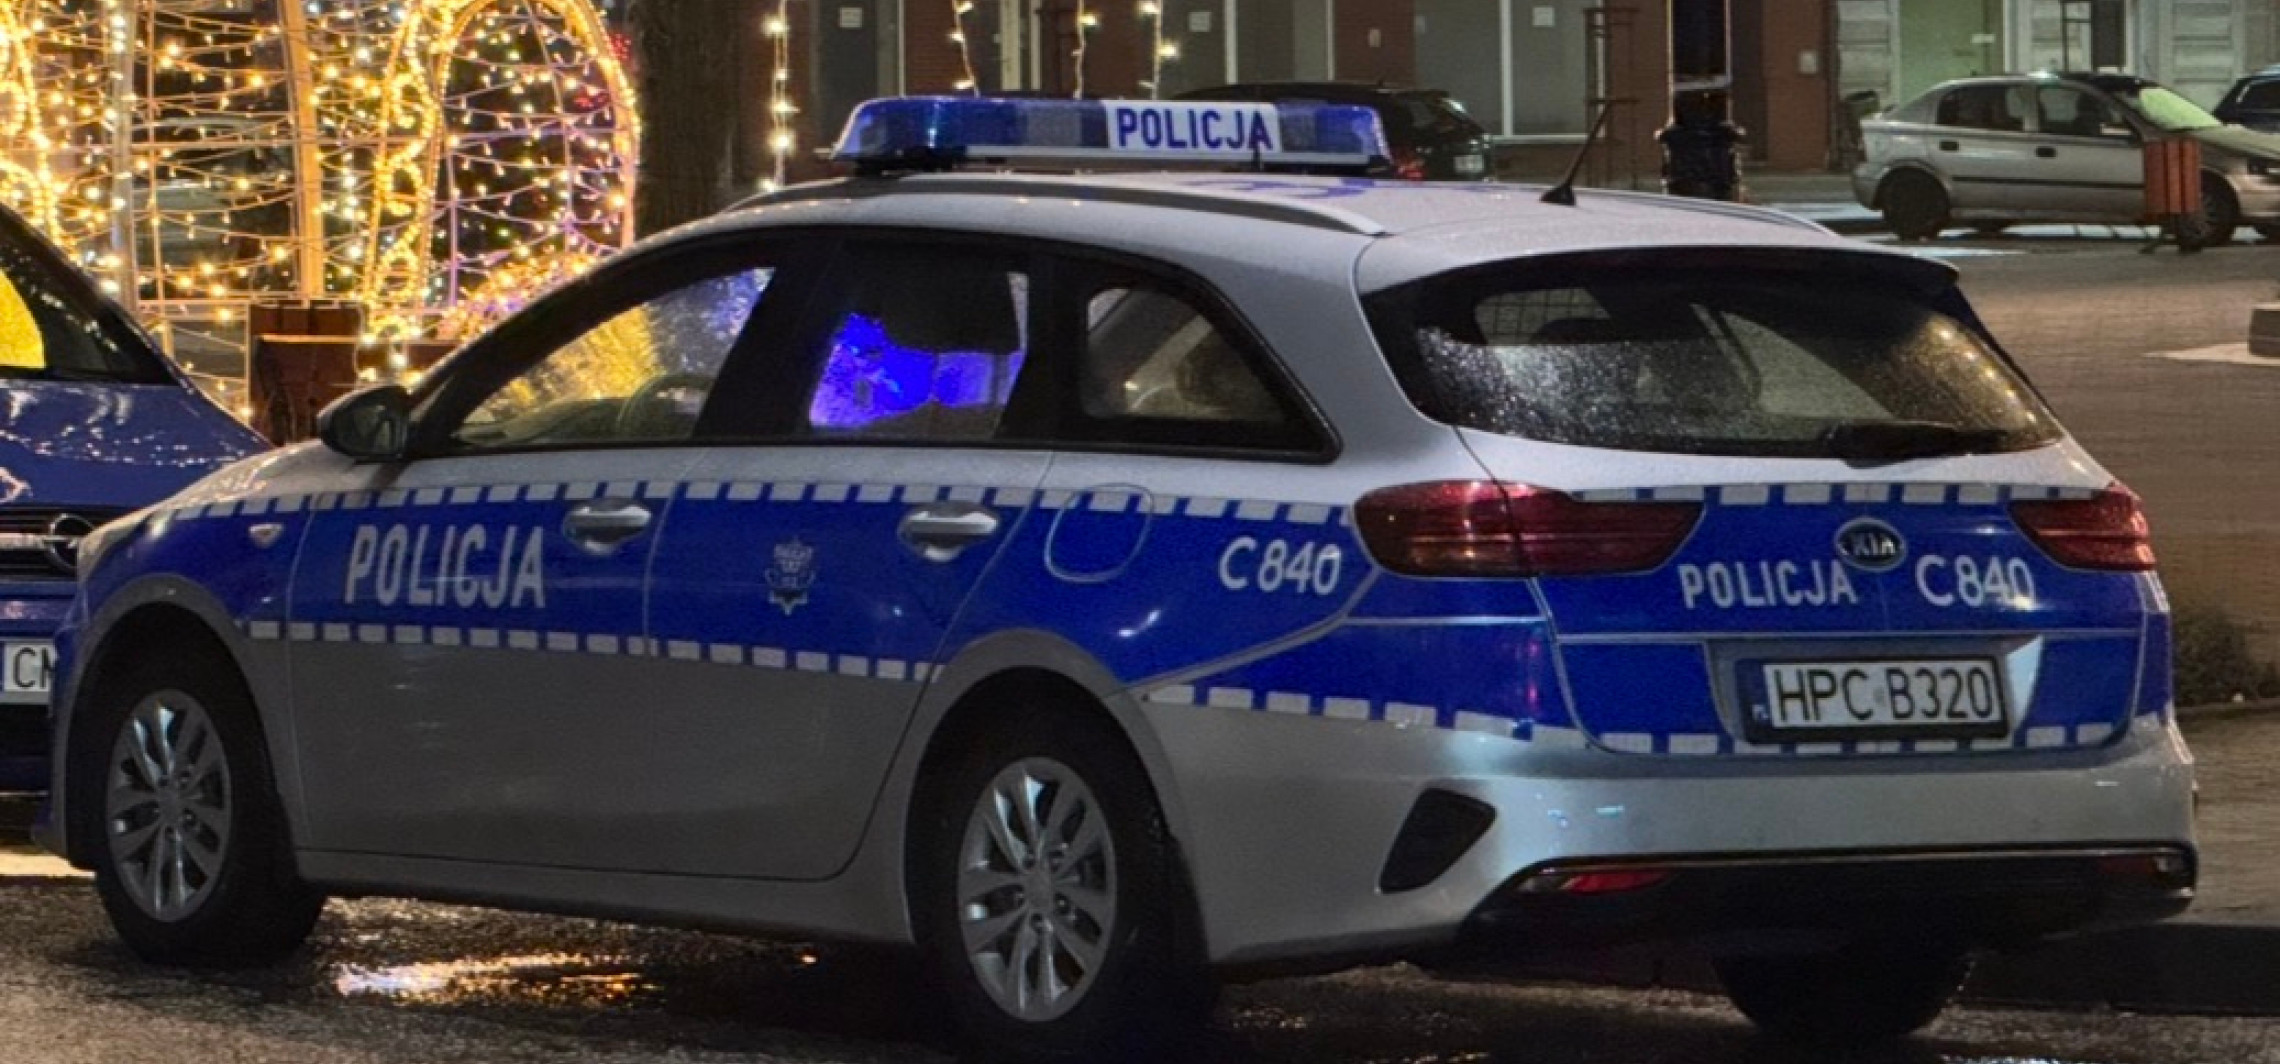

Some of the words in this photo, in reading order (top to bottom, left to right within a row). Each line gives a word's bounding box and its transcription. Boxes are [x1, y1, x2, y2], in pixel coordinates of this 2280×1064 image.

[1116, 107, 1273, 150] POLICJA
[344, 524, 546, 608] POLICJA
[1678, 559, 1858, 609] POLICJA
[1774, 668, 1873, 721] HPC
[1886, 667, 1992, 719] B320
